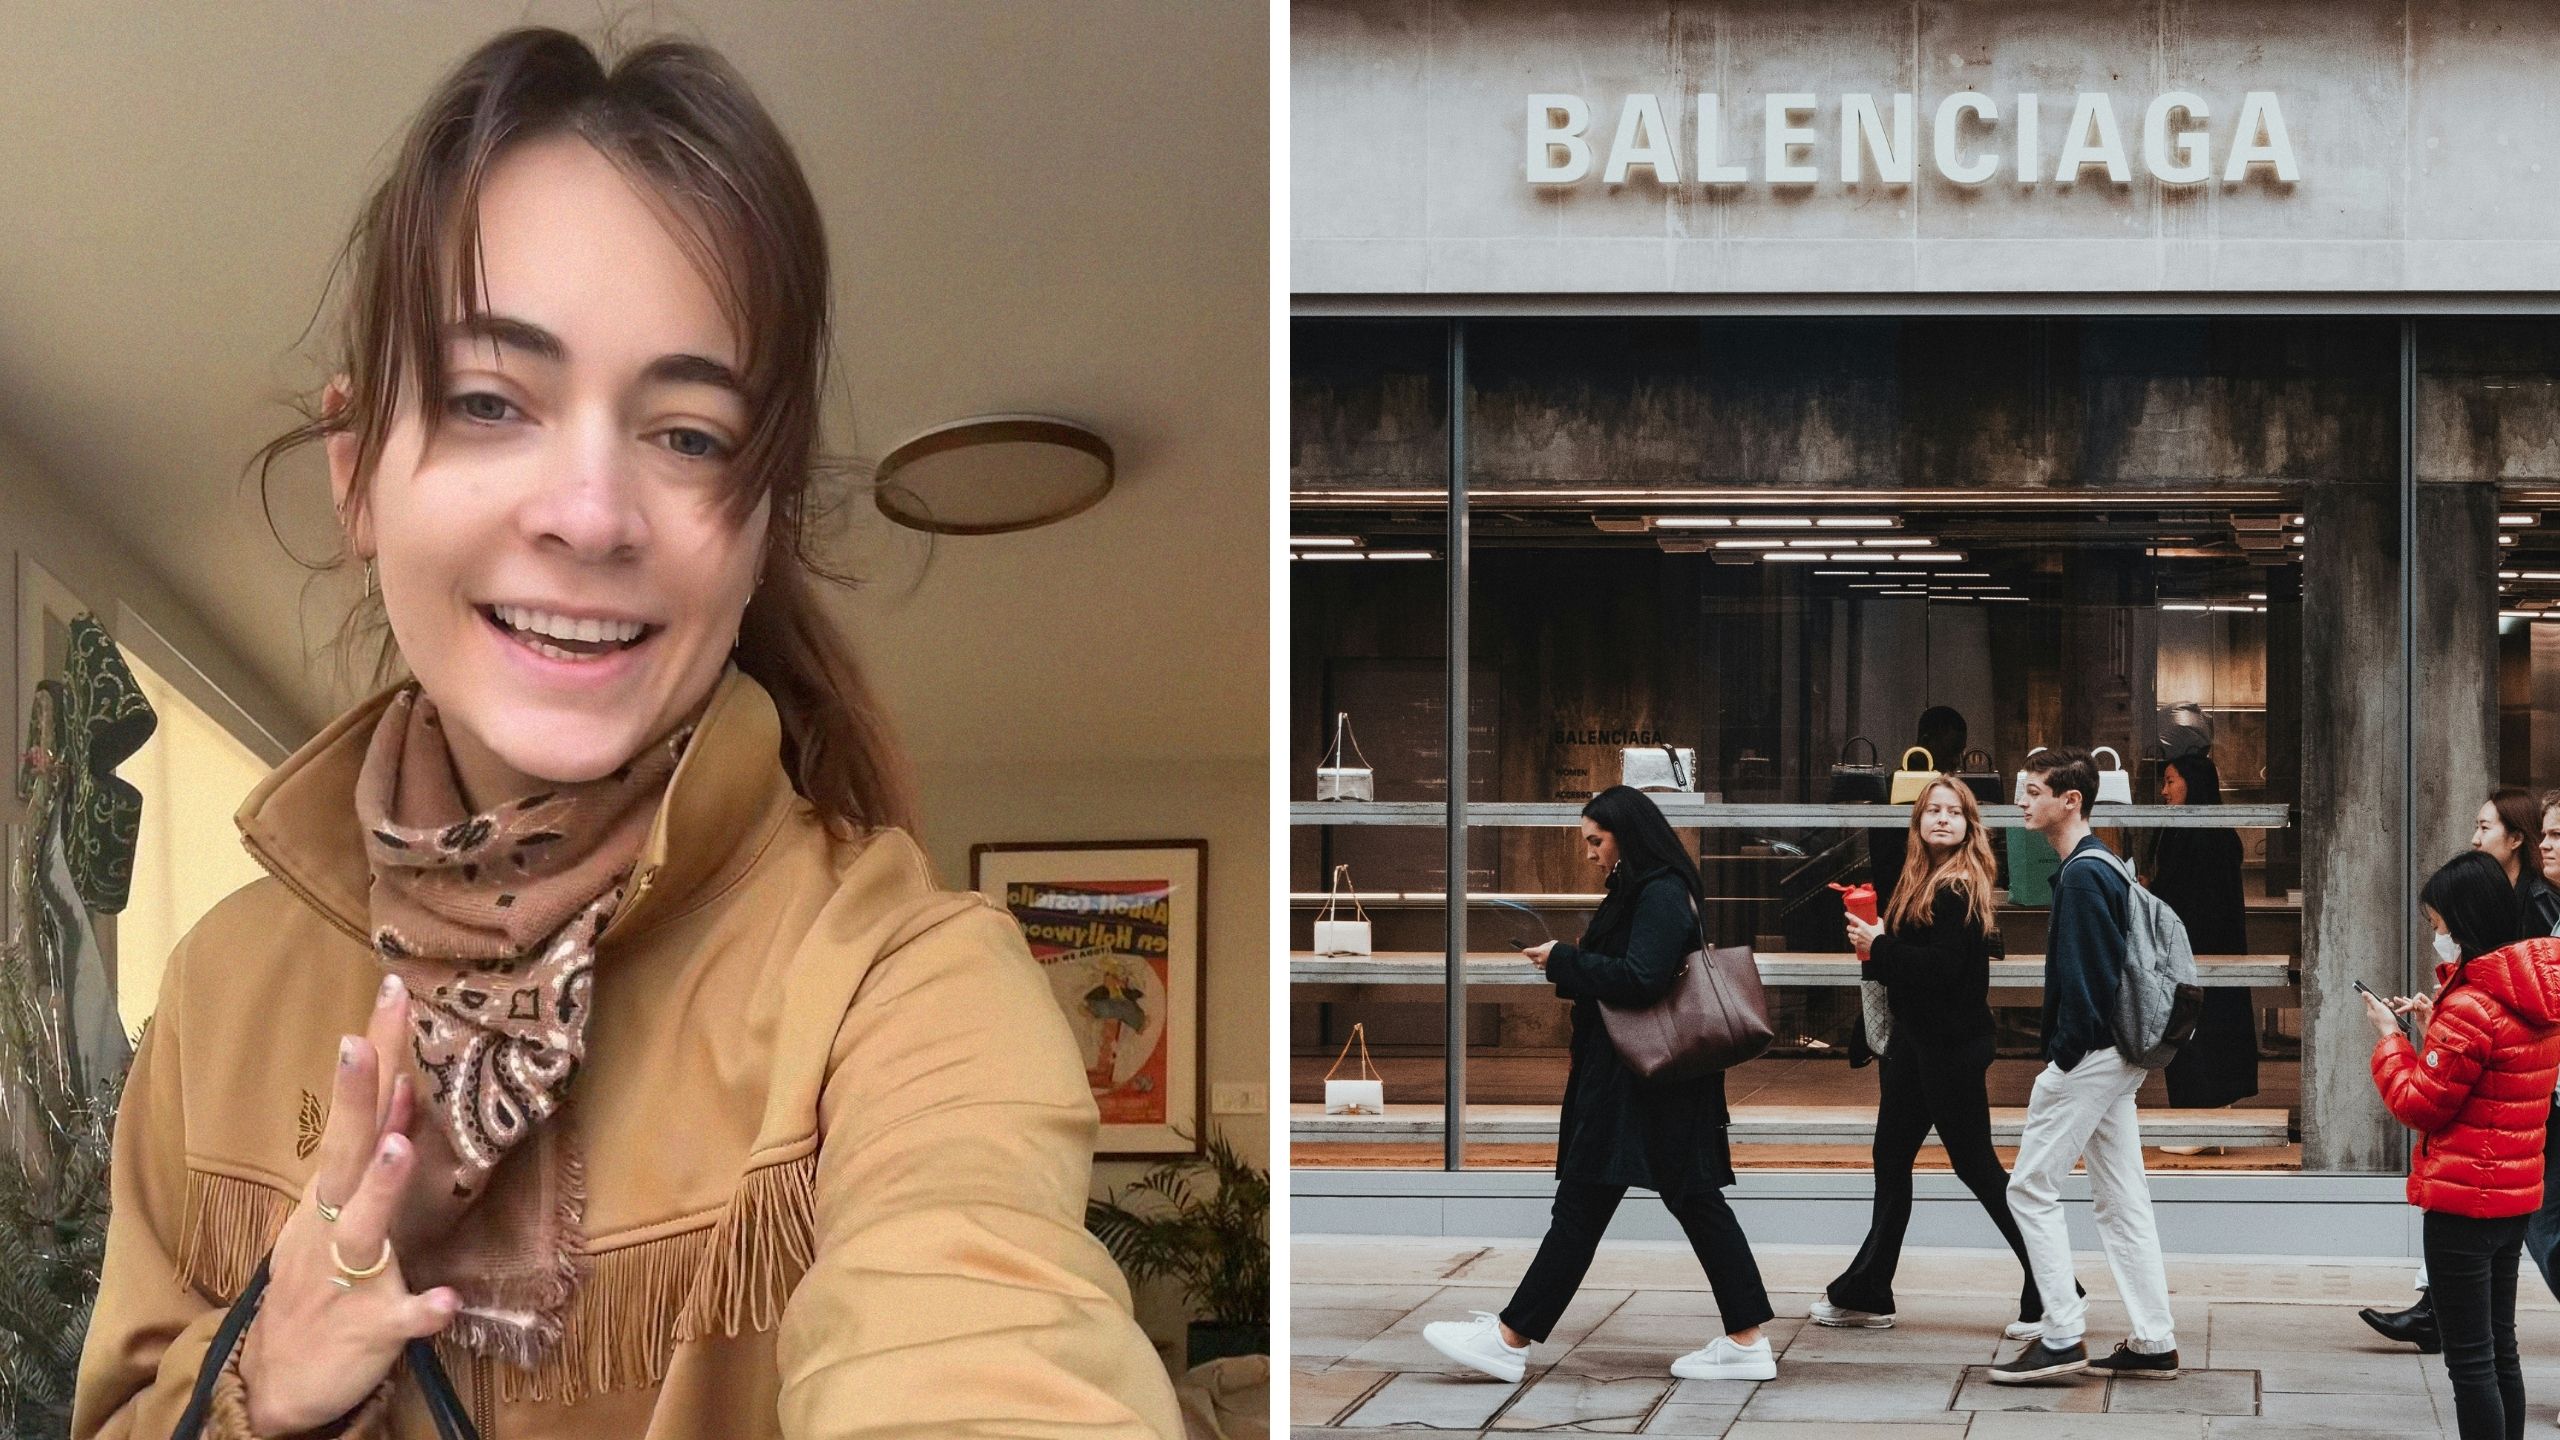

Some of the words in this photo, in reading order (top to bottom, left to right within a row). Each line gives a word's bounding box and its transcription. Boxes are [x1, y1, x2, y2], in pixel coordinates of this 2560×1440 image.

[1526, 91, 2301, 185] BALENCIAGA
[1555, 730, 1662, 745] BALENCIAGA
[1556, 768, 1587, 777] WOMEN
[1555, 791, 1593, 799] ACCESSO
